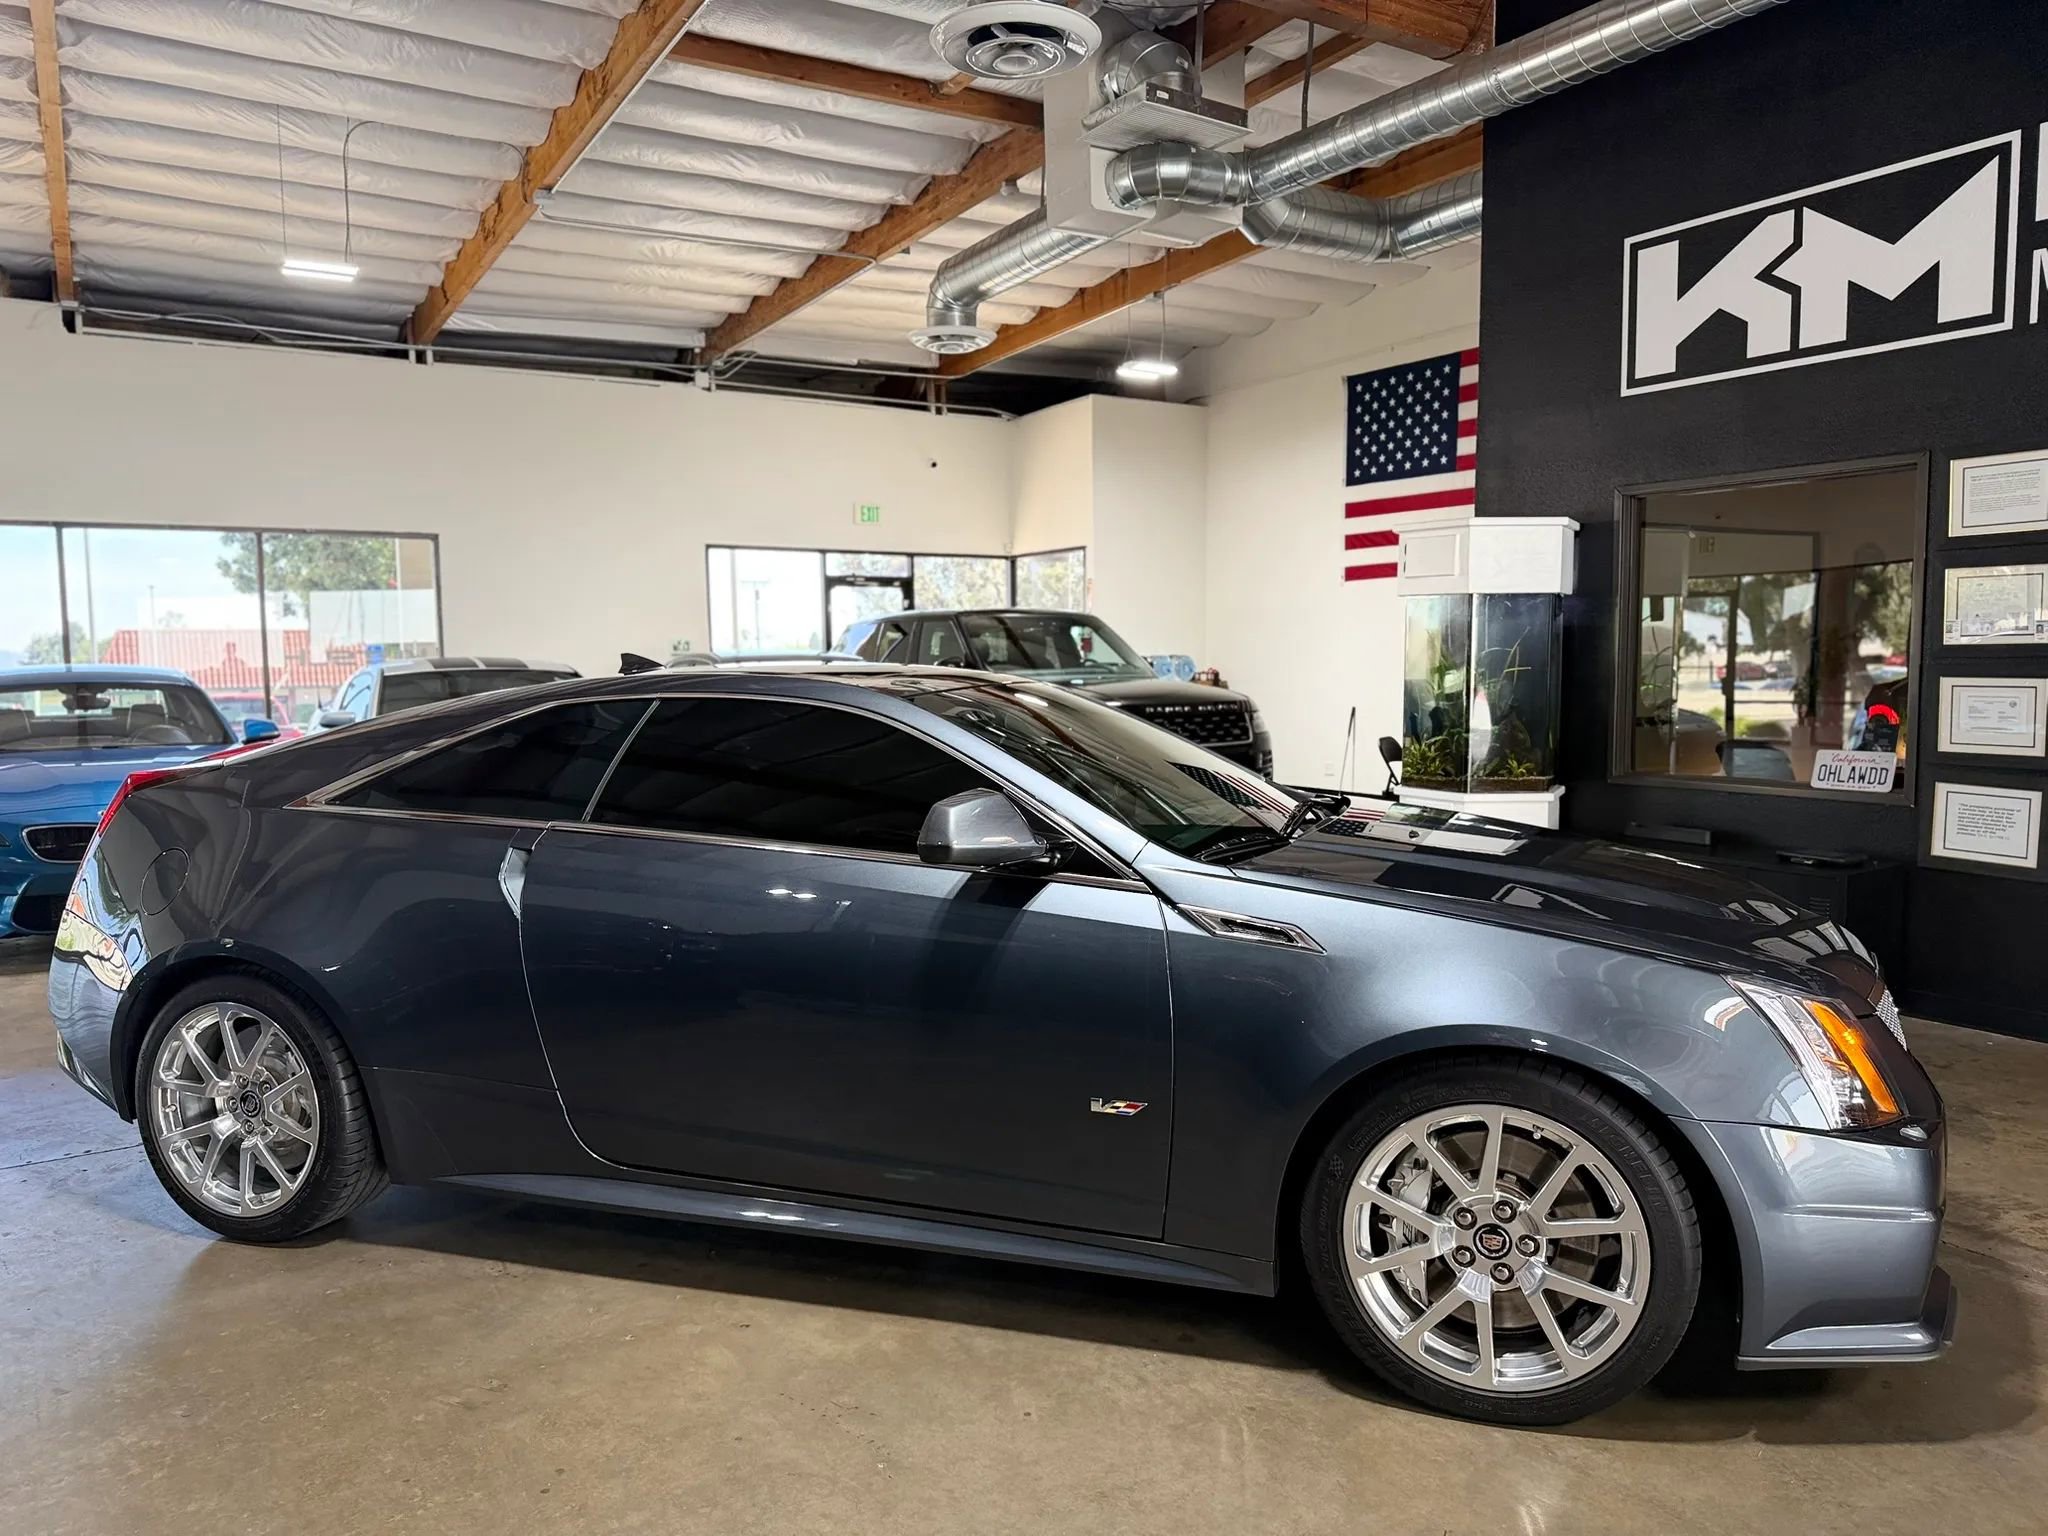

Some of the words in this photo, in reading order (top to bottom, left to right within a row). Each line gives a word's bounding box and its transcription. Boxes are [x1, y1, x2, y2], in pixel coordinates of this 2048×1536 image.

[1635, 155, 1999, 379] KM
[860, 504, 881, 523] EXIT
[1832, 753, 1879, 764] California
